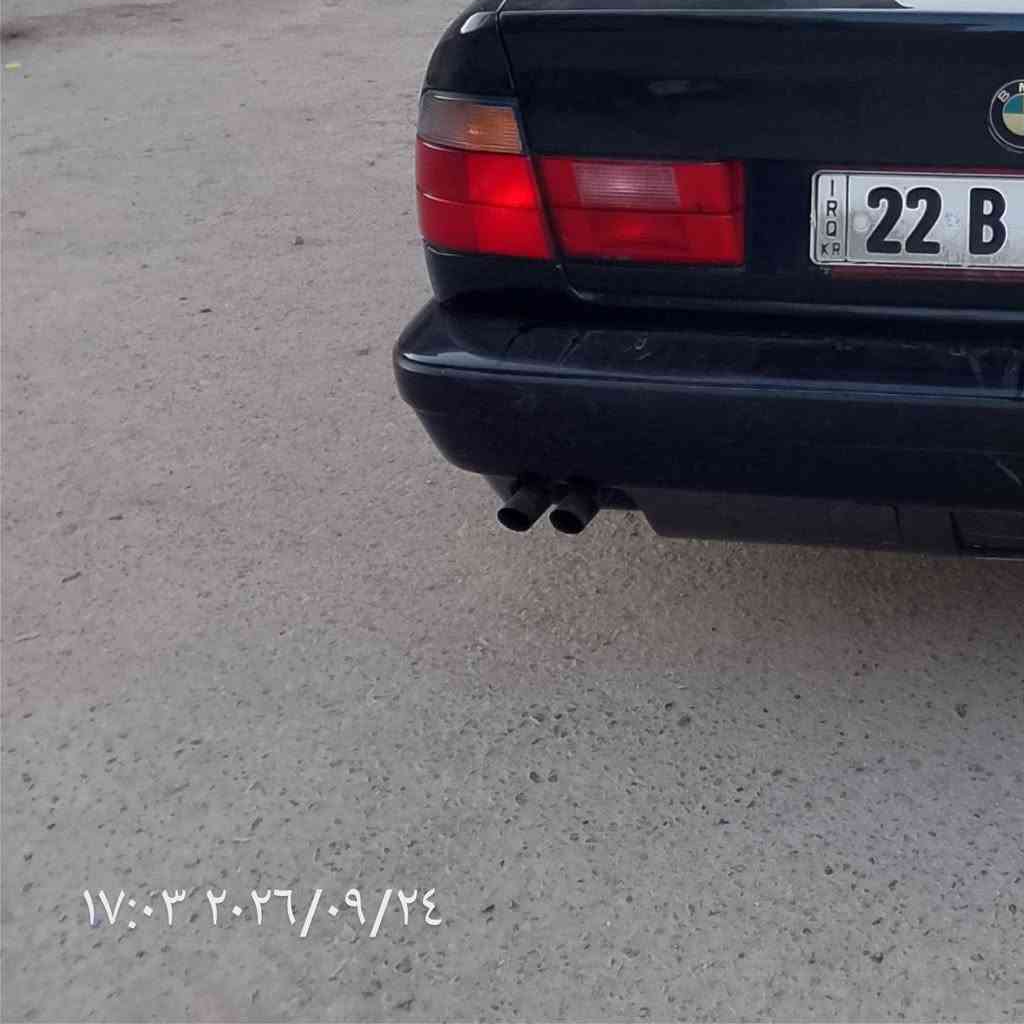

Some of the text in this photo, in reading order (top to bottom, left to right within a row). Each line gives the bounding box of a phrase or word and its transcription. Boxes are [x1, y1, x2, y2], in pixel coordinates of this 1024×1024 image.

[866, 187, 942, 255] 22
[968, 187, 1006, 256] B
[821, 242, 841, 257] KR
